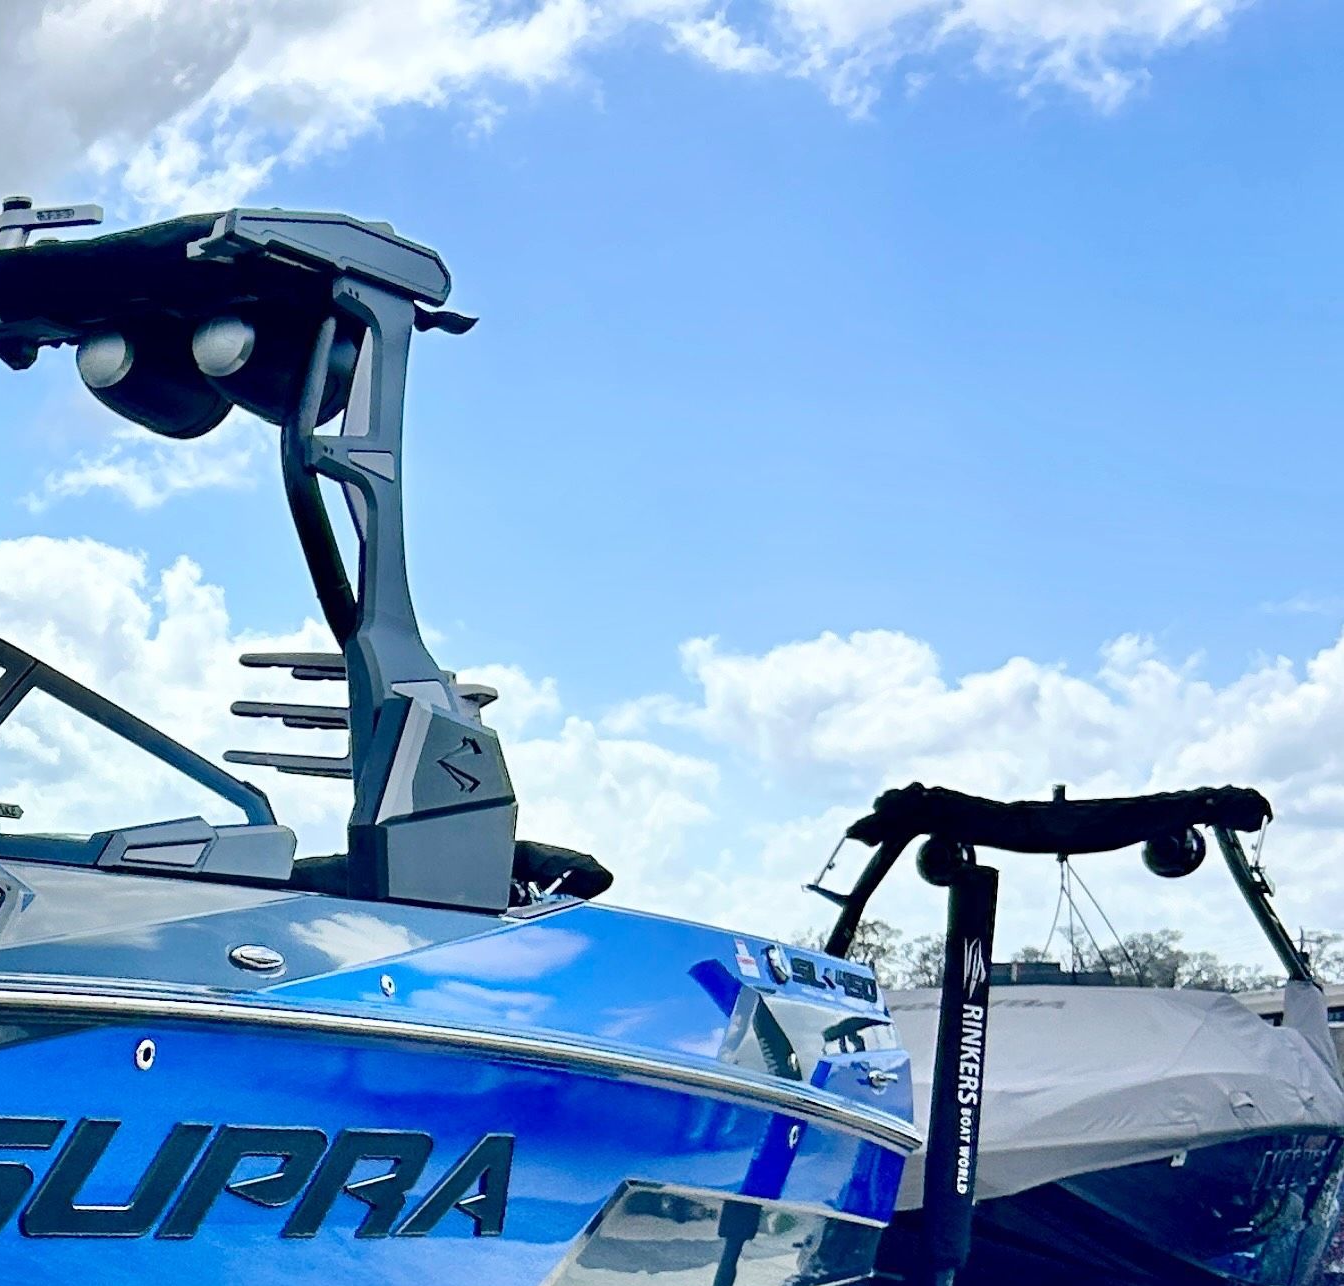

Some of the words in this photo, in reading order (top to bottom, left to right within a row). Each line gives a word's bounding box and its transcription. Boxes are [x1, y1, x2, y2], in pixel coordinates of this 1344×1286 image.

[957, 1003, 984, 1107] RINKERS
[958, 1107, 973, 1141] BOAT
[956, 1142, 971, 1195] WORLD
